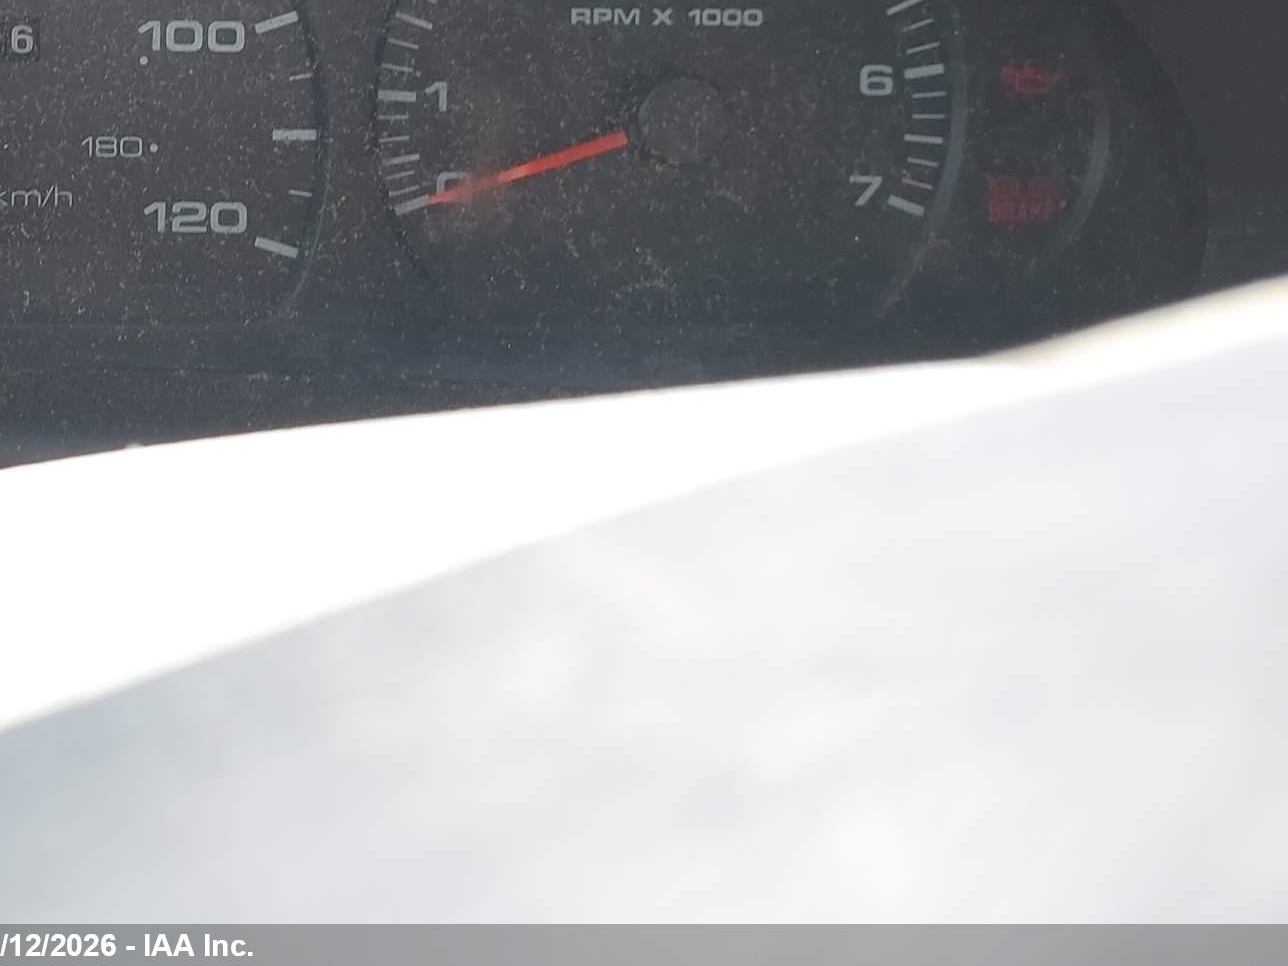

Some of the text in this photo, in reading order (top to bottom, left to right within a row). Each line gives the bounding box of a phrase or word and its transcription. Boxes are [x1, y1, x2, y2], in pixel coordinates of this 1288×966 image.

[570, 7, 763, 27] RPM X 1000
[138, 19, 245, 53] 100
[859, 64, 894, 96] 6
[424, 81, 448, 112] 1
[81, 136, 143, 158] 180
[849, 174, 883, 206] 7
[143, 200, 248, 234] 120
